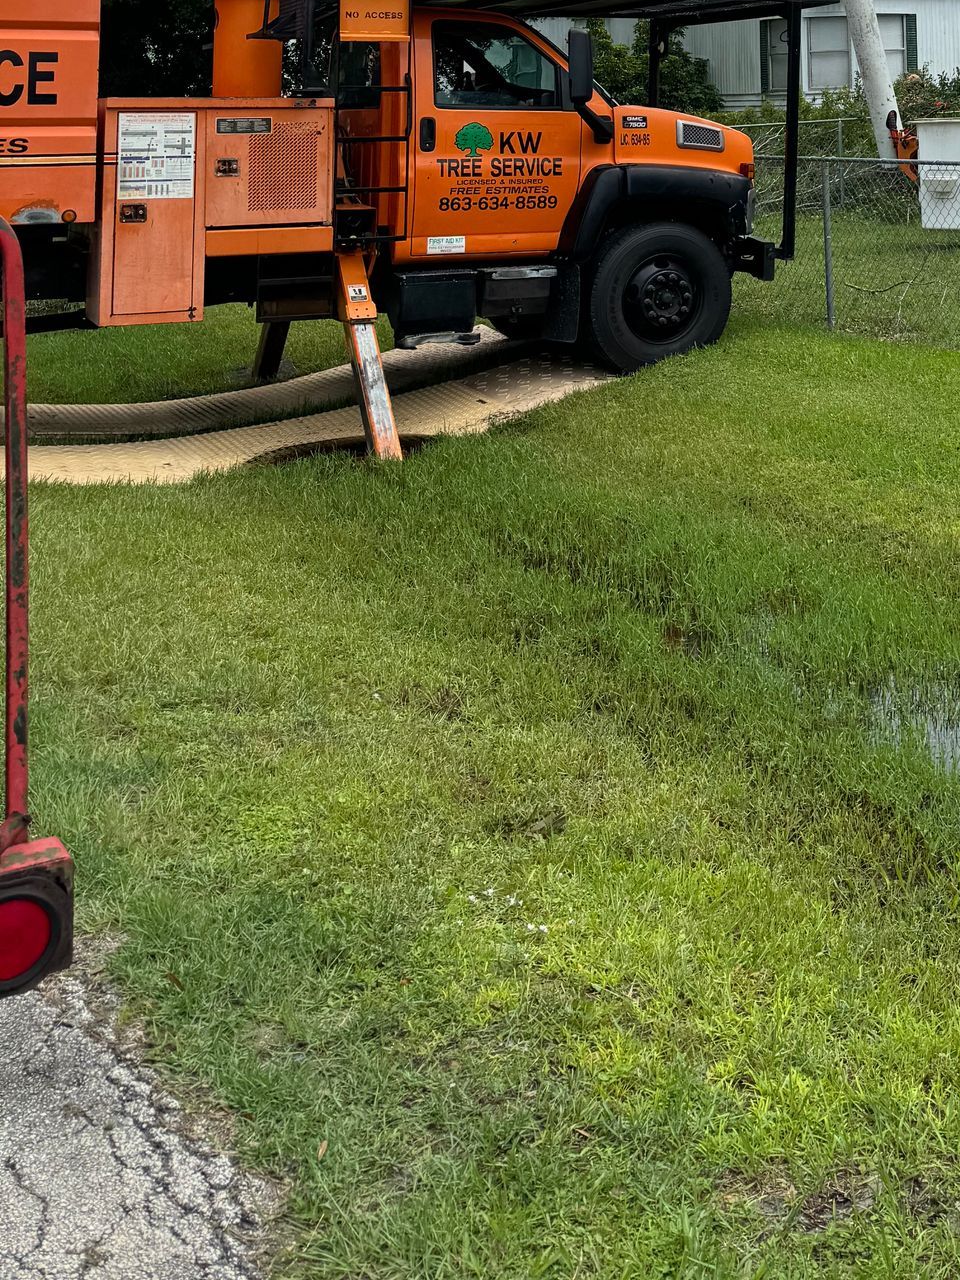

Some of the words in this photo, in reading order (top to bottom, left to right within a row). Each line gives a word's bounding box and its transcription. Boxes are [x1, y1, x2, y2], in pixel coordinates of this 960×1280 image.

[345, 11, 359, 19] NO
[364, 11, 403, 20] ACCESS
[499, 131, 542, 154] KW
[436, 158, 482, 177] TREE
[490, 157, 563, 177] SERVICE
[449, 186, 481, 195] FREE
[485, 185, 549, 195] ESTIMATES
[438, 195, 558, 211] 863-634-8589
